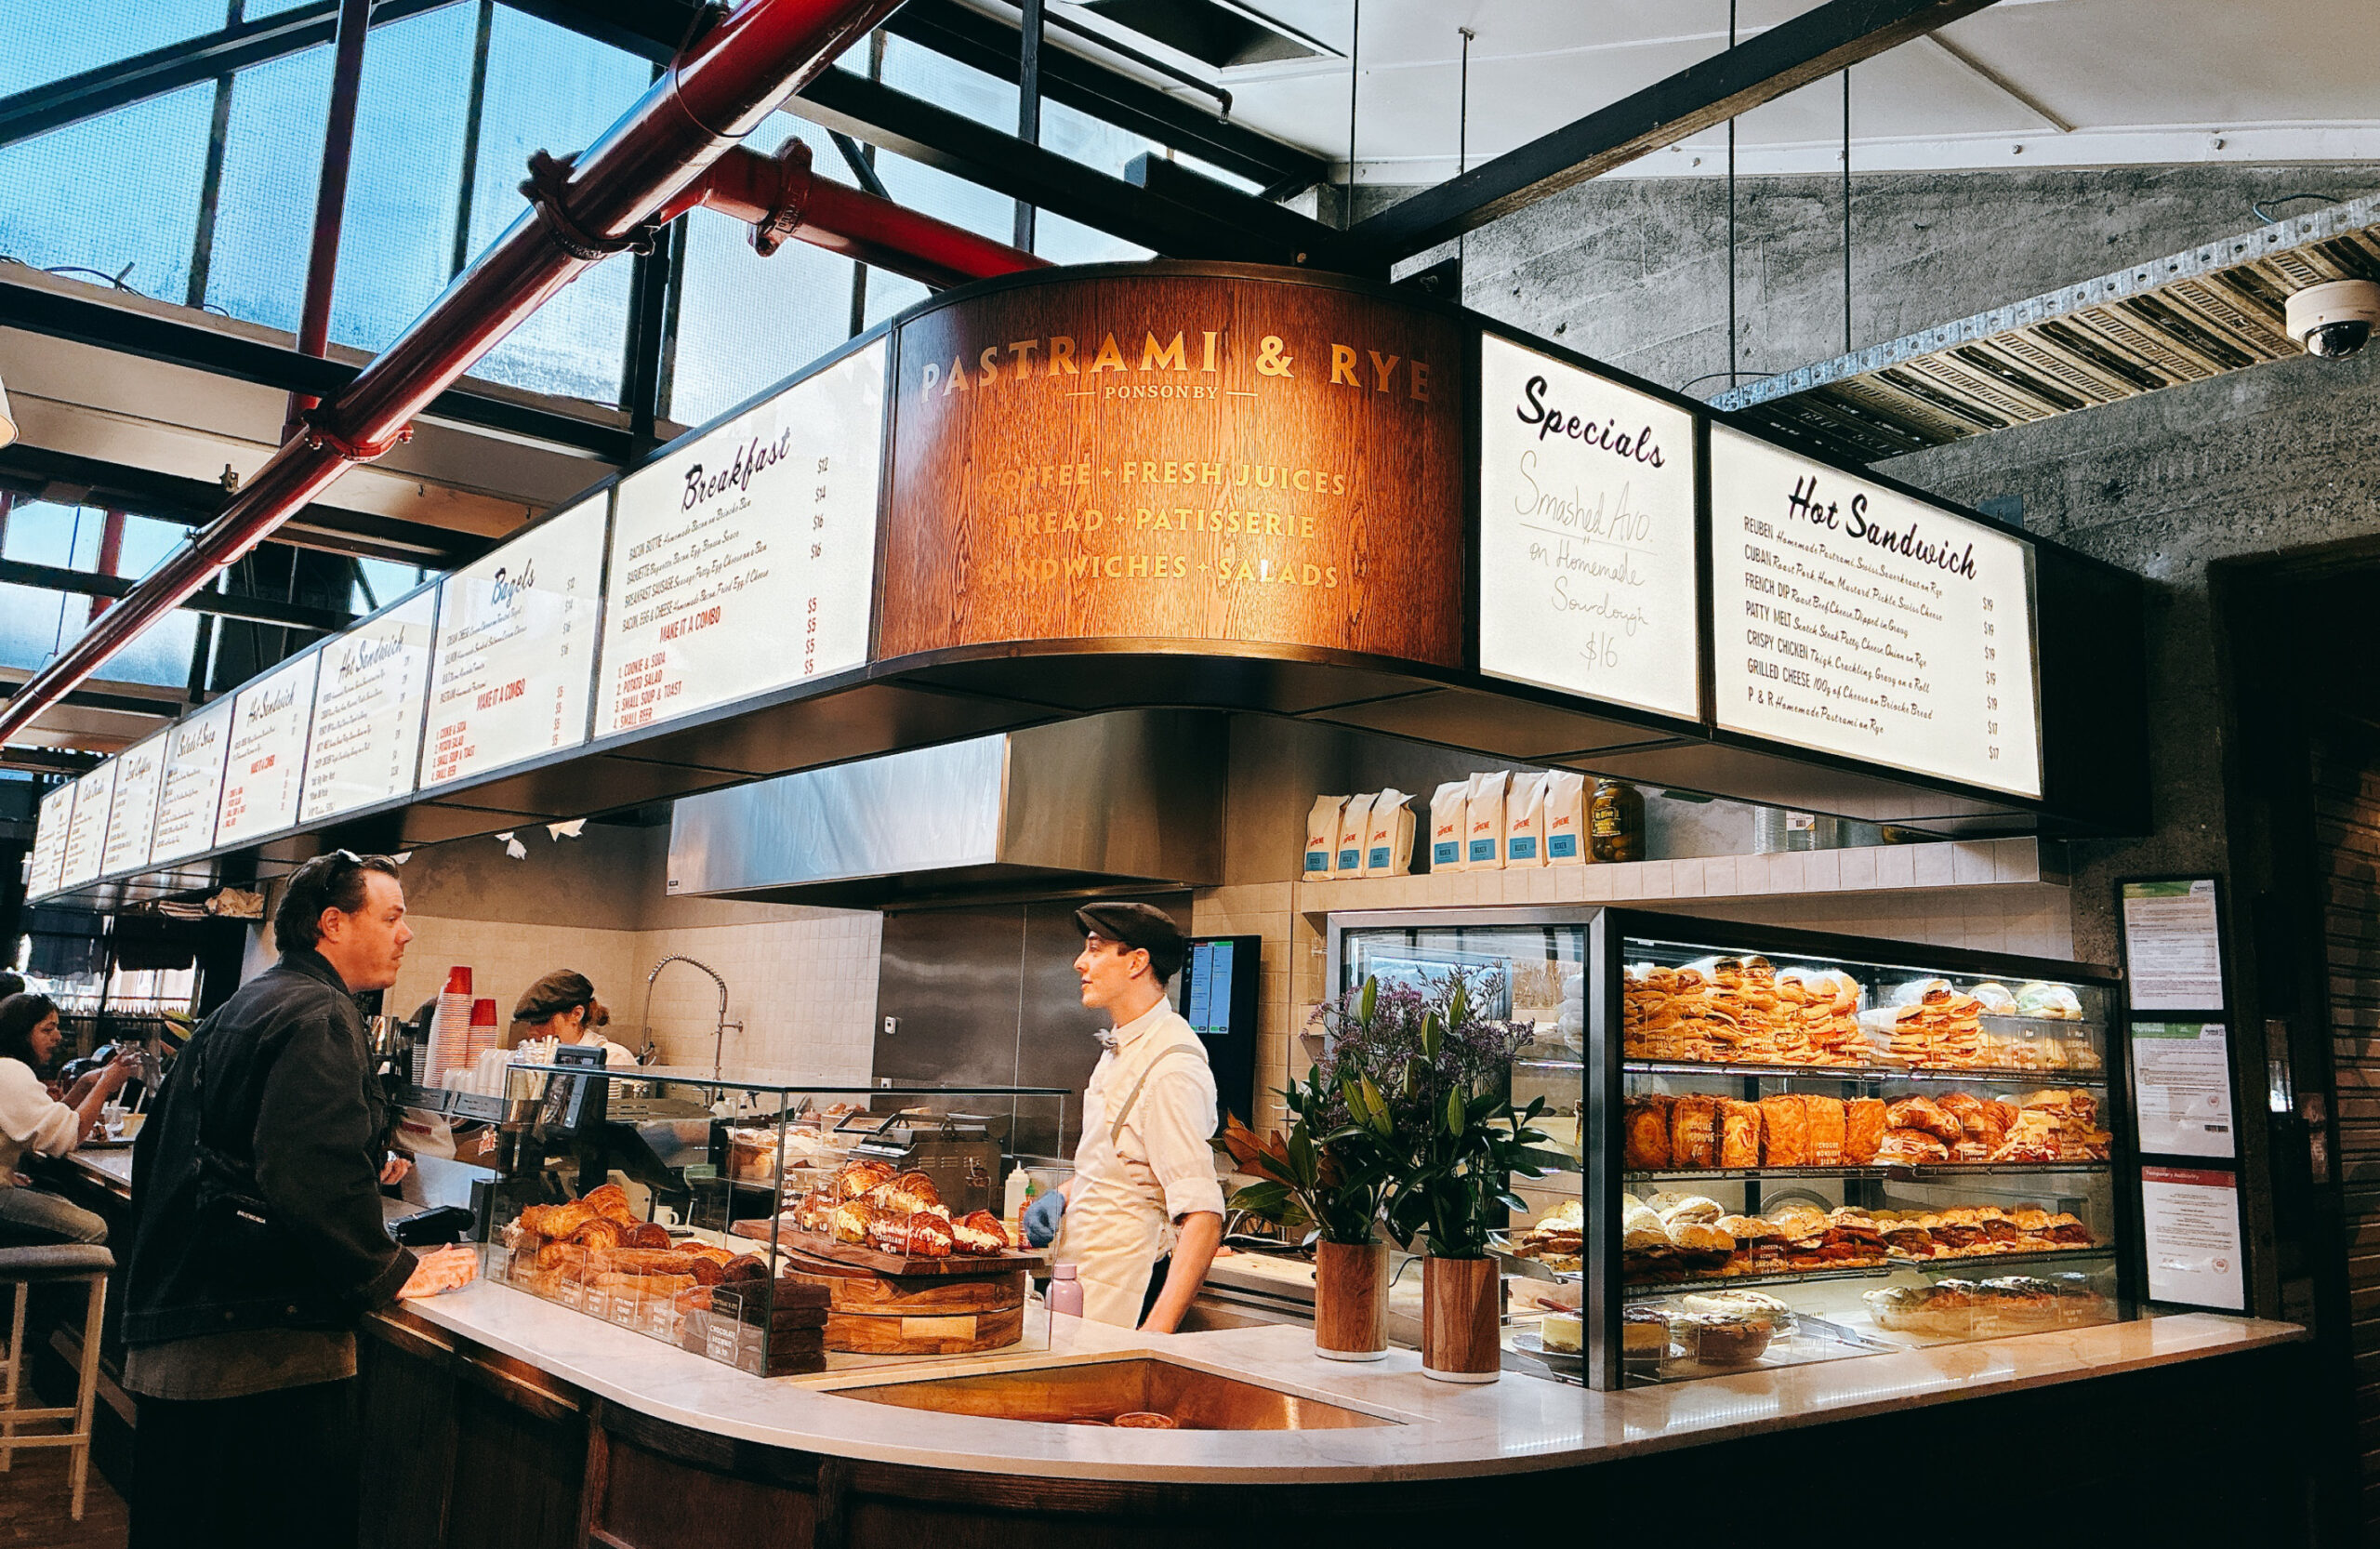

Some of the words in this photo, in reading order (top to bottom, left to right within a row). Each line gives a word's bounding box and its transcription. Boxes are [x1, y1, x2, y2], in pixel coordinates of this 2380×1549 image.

[920, 330, 1218, 404] PASTRAMI
[1255, 335, 1295, 378] &
[1329, 343, 1430, 404] RYE
[1104, 385, 1220, 401] PONSONBY
[1516, 375, 1666, 469] Specials
[681, 426, 791, 513] Breakfast
[817, 457, 828, 474] $12
[983, 463, 1091, 496] COFFEE
[1121, 461, 1223, 486] FRESH
[1236, 463, 1346, 496] JUICES
[1514, 450, 1606, 536] Smashed
[1006, 509, 1103, 538] BREAD
[1135, 508, 1315, 539] PATISSERIE
[1789, 476, 1838, 529] Hot
[1846, 495, 1975, 578] Sandwich
[491, 557, 536, 609] Bagels
[982, 555, 1188, 589] SANDWICHES
[1218, 558, 1339, 589] SALADS
[1556, 536, 1646, 587] Homemade
[1744, 516, 1773, 538] REUBEN
[1776, 530, 1817, 554] Homemade
[1878, 564, 1919, 588] Sauerkraut
[1920, 584, 1928, 592] on
[1930, 581, 1942, 599] Rye
[1982, 596, 1993, 611] $19
[1744, 544, 1771, 565] CUBAN
[1772, 555, 1794, 574] Roast
[1897, 596, 1919, 614] Swiss
[1920, 603, 1942, 621] Cheese
[1983, 621, 1993, 636] $19
[659, 621, 679, 642] MAKE
[679, 617, 687, 636] IT
[687, 616, 693, 633] A
[695, 605, 721, 629] COMBO
[807, 597, 816, 614] $5
[1551, 576, 1649, 636] Sourdough
[1745, 572, 1774, 594] FRENCH
[1778, 582, 1790, 599] DIP
[1812, 595, 1830, 614] Beef
[1880, 620, 1888, 629] in
[1888, 618, 1908, 639] Gravy
[1984, 645, 1995, 660] $19
[621, 695, 638, 710] SMALL
[641, 689, 654, 705] SOUP
[664, 681, 681, 697] TOAST
[805, 638, 814, 655] $5
[643, 669, 662, 687] SALAD
[807, 616, 816, 633] $5
[1580, 631, 1619, 670] $16
[1745, 600, 1769, 620] PATTY
[1773, 608, 1791, 627] MELT
[1792, 616, 1817, 635] Scotch
[1818, 624, 1839, 642] Steak
[1884, 643, 1904, 660] Onion
[1914, 652, 1926, 669] Rye
[1986, 670, 1996, 685] $19
[1747, 629, 1774, 649] CRISPY
[1778, 638, 1807, 659] CHICKEN
[1874, 667, 1896, 687] Gravy
[1914, 677, 1929, 693] Roll
[1987, 695, 1997, 710] $19
[498, 686, 503, 703] A
[620, 711, 637, 728] SMALL
[639, 707, 653, 722] BEER
[804, 658, 813, 674] $5
[1747, 657, 1778, 679] GRILLED
[1782, 667, 1810, 688] CHEESE
[1813, 677, 1831, 696] 100g
[1832, 685, 1842, 698] of
[1843, 684, 1868, 703] Cheese
[1880, 695, 1909, 713] Brioche
[1911, 702, 1933, 719] Bread
[1988, 720, 1997, 735] $17
[1748, 685, 1753, 701] P
[1757, 689, 1764, 704] &
[1767, 691, 1773, 706] R
[1775, 695, 1818, 717] Homemade
[1820, 706, 1858, 727] Pastrami
[1870, 718, 1883, 735] Rye
[1989, 745, 1999, 760] $17
